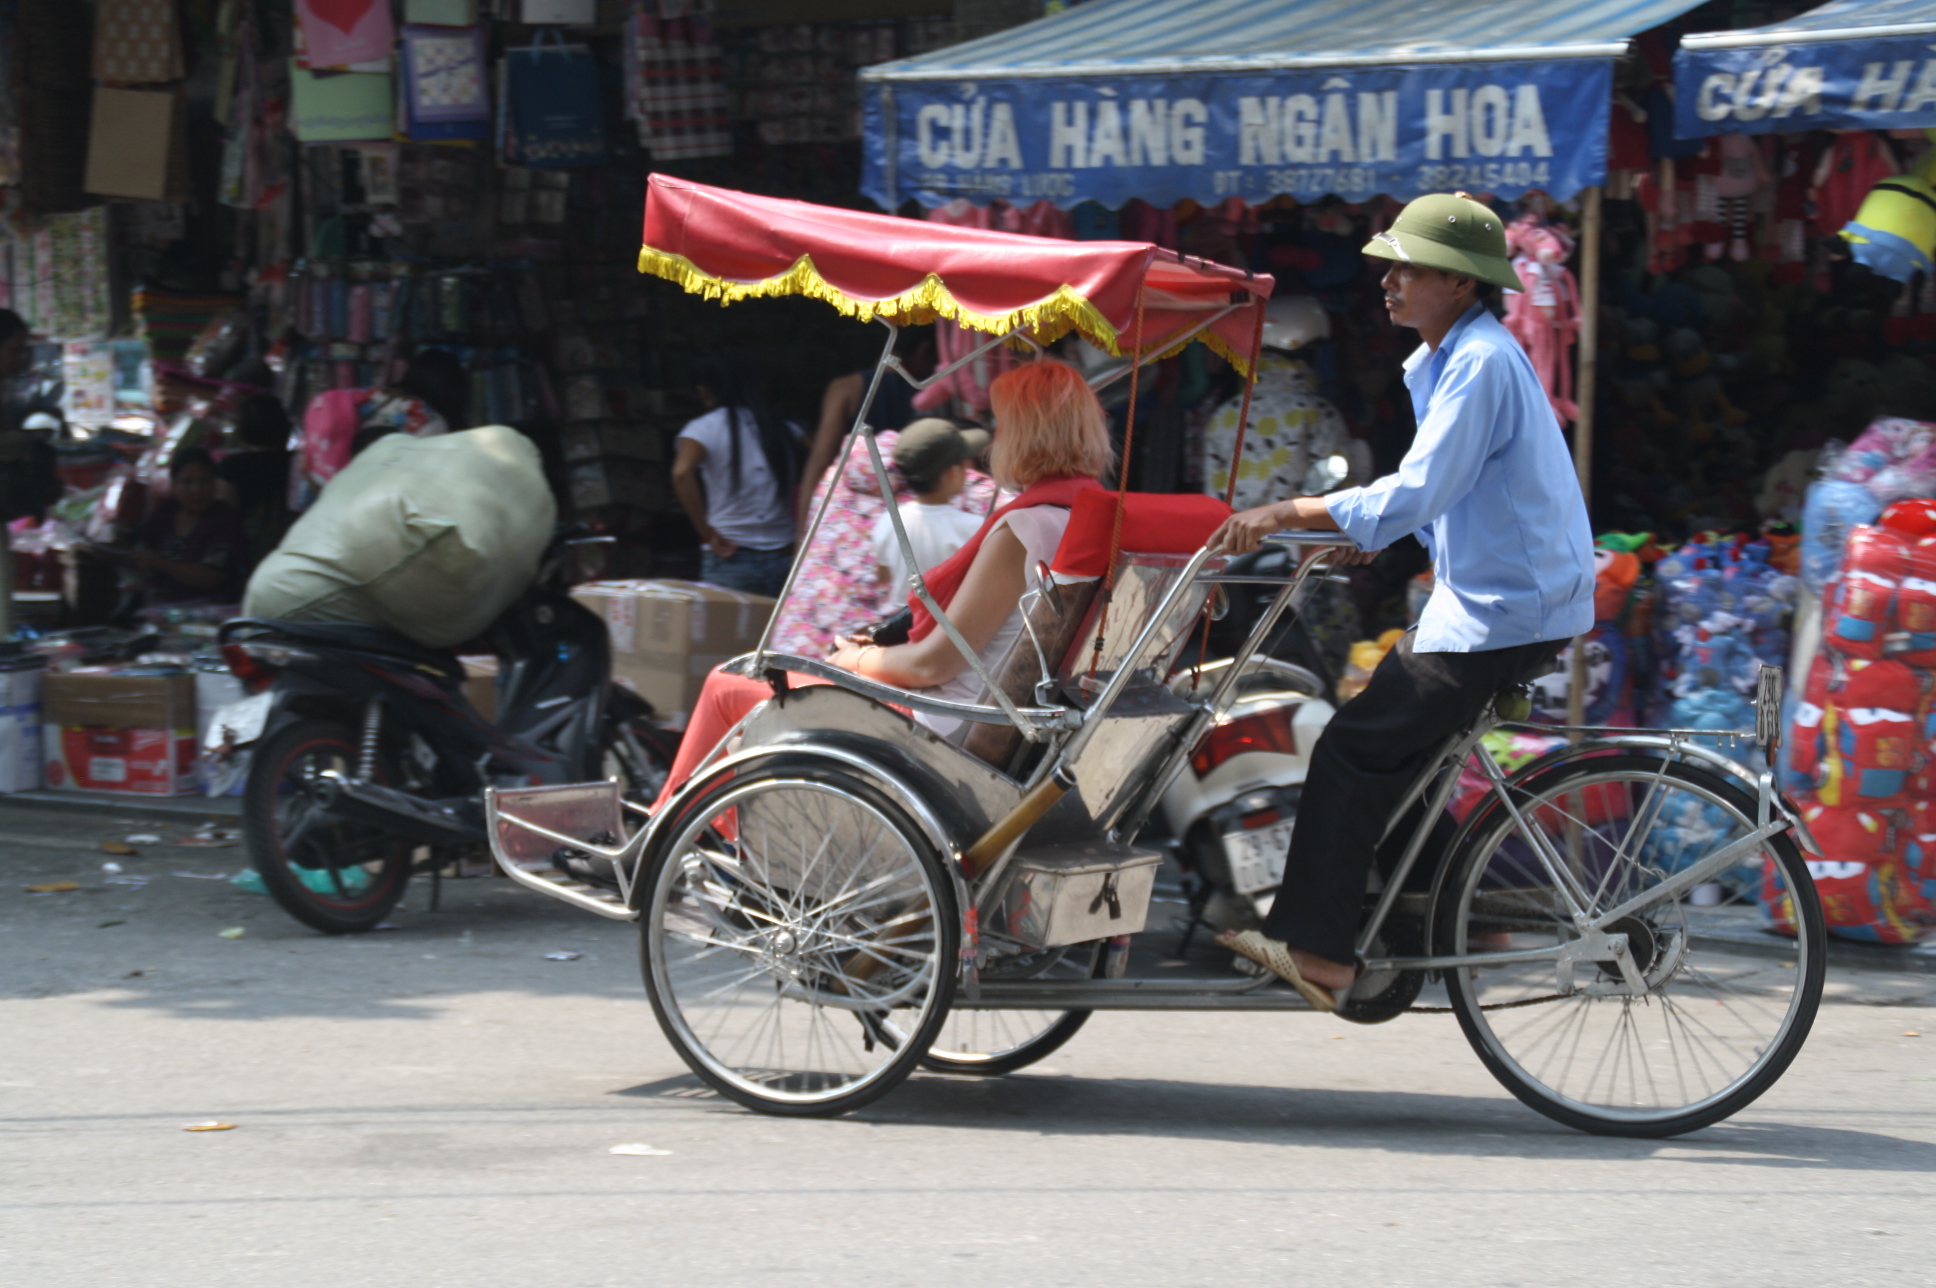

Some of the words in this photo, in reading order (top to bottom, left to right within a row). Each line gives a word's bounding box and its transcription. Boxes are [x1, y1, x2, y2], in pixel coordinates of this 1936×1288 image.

[917, 83, 1023, 169] CỬA
[1049, 86, 1208, 168] HÀNG
[1239, 77, 1398, 165] NGÂN
[1425, 84, 1554, 160] HOA
